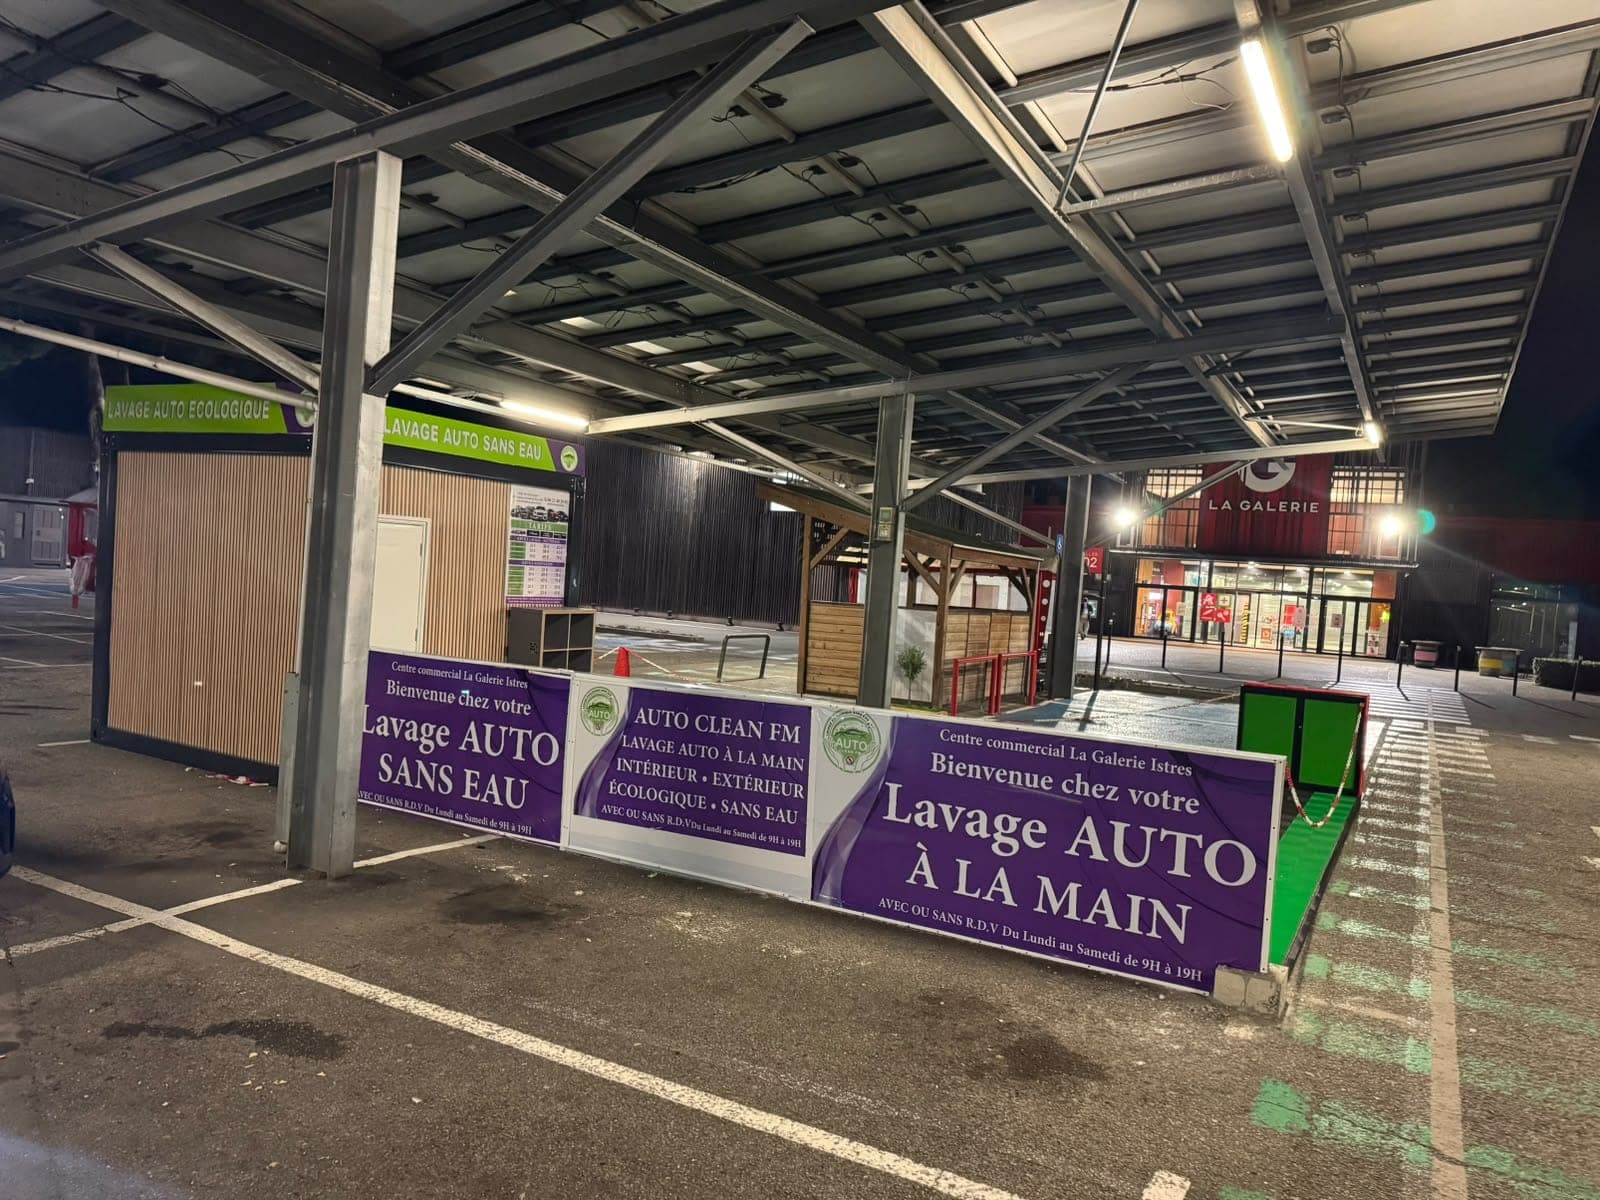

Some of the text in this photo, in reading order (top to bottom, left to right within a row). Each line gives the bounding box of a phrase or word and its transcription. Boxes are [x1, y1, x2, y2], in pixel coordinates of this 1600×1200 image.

[108, 400, 270, 419] LAVAGE AUTO ECOLOGIQUE
[385, 416, 542, 460] LAVAGE AUTO SANS EAU
[1209, 500, 1320, 513] LA GALERIE
[391, 661, 528, 689] Centre commercial La Galerie Istres
[386, 679, 532, 716] Bienvenue chez votre
[588, 708, 610, 720] AUTO
[362, 704, 560, 766] Lavage AUTO
[634, 707, 689, 729] AUTO
[694, 715, 762, 739] CLEAN
[769, 724, 801, 745] FM
[836, 737, 868, 752] AUTO
[621, 734, 804, 772] LAVAGE AUTO À LA MAIN
[939, 728, 1193, 777] Centre commercial La Galerie Istres
[378, 753, 530, 809] SANS EAU
[616, 756, 804, 800] INTÉRIEUR EXTÉRIEUR
[930, 751, 1201, 816] Bienvenue chez votre
[373, 793, 385, 803] OU
[385, 795, 403, 807] SANS
[404, 799, 423, 812] R.D.V
[424, 804, 434, 814] Du
[435, 807, 453, 818] Lundi
[464, 812, 488, 826] Samedi
[489, 818, 498, 828] de
[498, 821, 510, 830] 9H
[517, 824, 532, 835] 19H
[608, 778, 798, 825] ÉCOLOGIQUE SANS EAU
[601, 804, 625, 817] AVEC
[626, 808, 640, 820] OU
[641, 811, 665, 825] SANS
[702, 823, 722, 835] Lundi
[723, 828, 731, 836] au
[733, 828, 757, 841] Samedi
[758, 834, 767, 843] de
[768, 835, 779, 844] 9H
[780, 837, 785, 845] à
[787, 838, 801, 848] 19H
[882, 782, 1257, 888] Lavage AUTO
[905, 841, 1193, 945] À LA MAIN
[878, 897, 1202, 982] AVEC OU SANS R.D.V Du Lundi au Samedi de 9H à 19H
